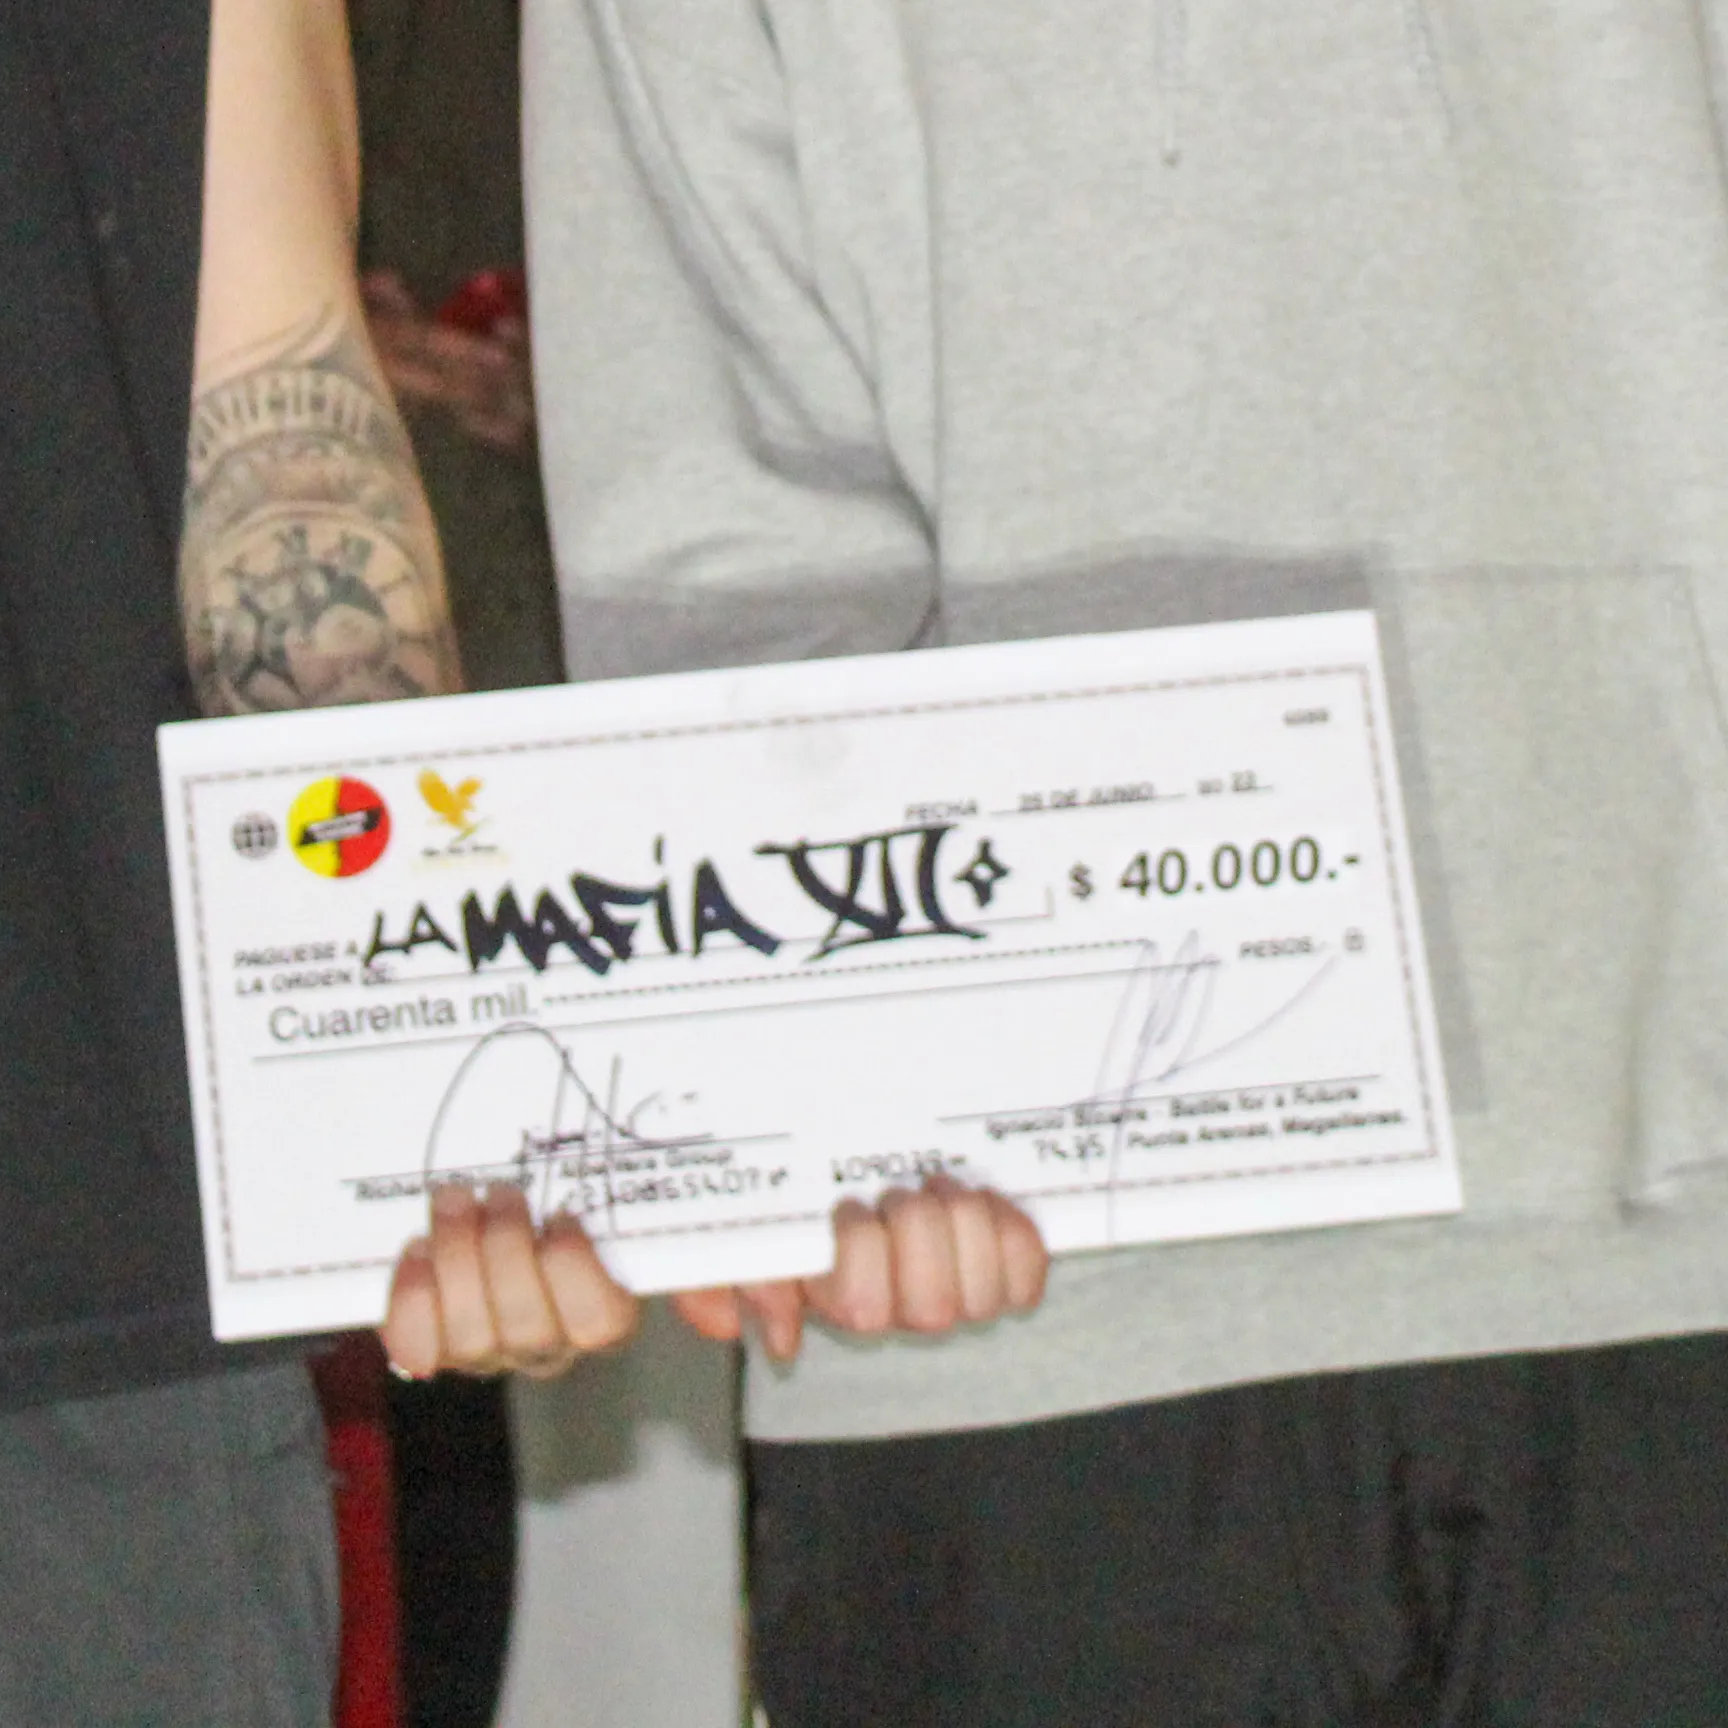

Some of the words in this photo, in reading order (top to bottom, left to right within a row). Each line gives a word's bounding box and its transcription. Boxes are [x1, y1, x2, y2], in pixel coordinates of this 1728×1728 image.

[1070, 862, 1094, 901] $
[363, 901, 458, 968] LA
[268, 992, 458, 1043] Cuarenta
